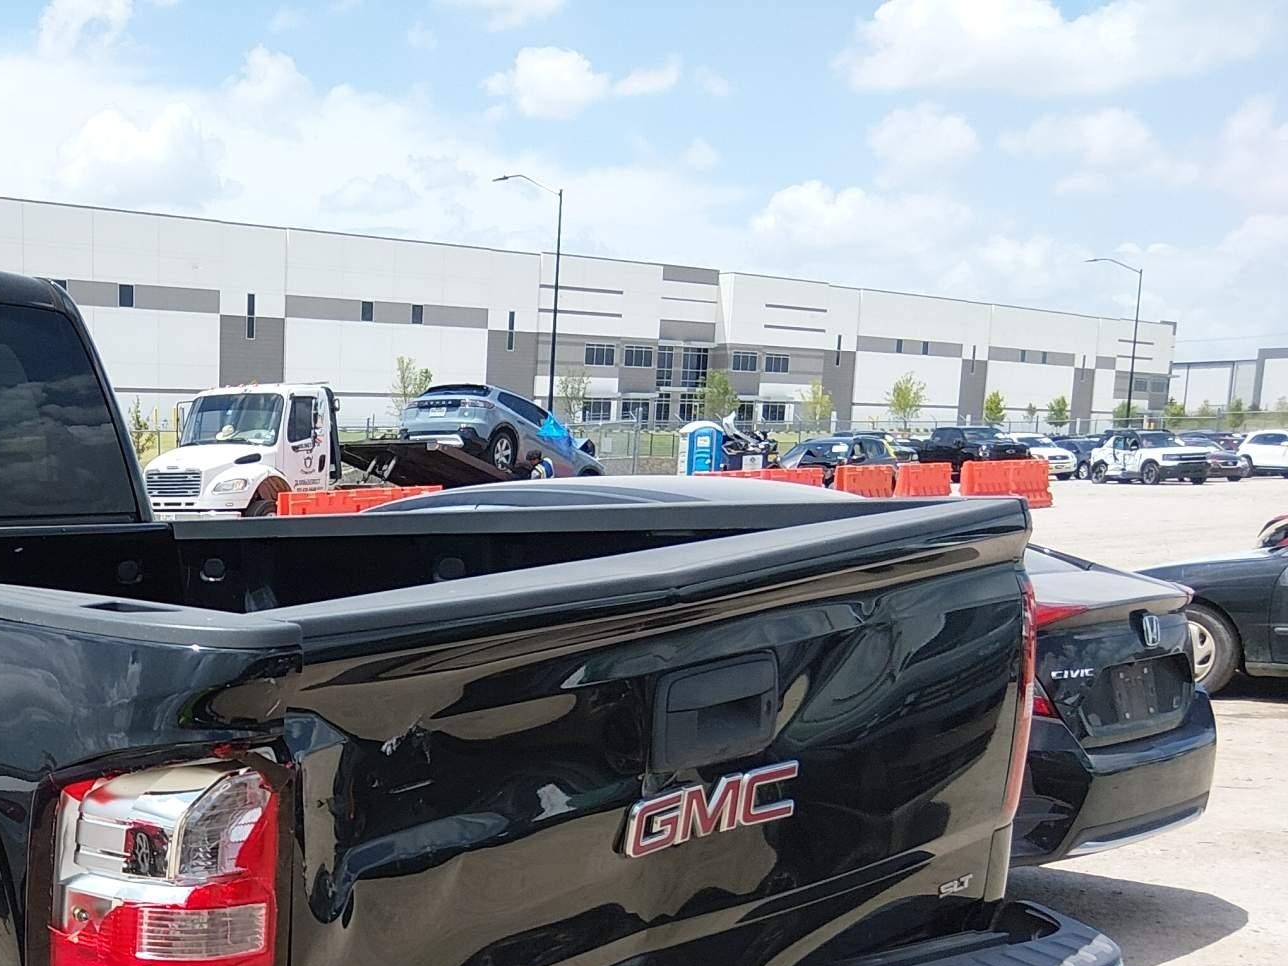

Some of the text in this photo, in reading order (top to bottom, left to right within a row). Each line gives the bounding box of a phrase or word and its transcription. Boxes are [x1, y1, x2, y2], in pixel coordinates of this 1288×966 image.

[1051, 667, 1095, 680] CIVIC
[625, 759, 799, 858] GMC
[939, 873, 973, 899] SLT
